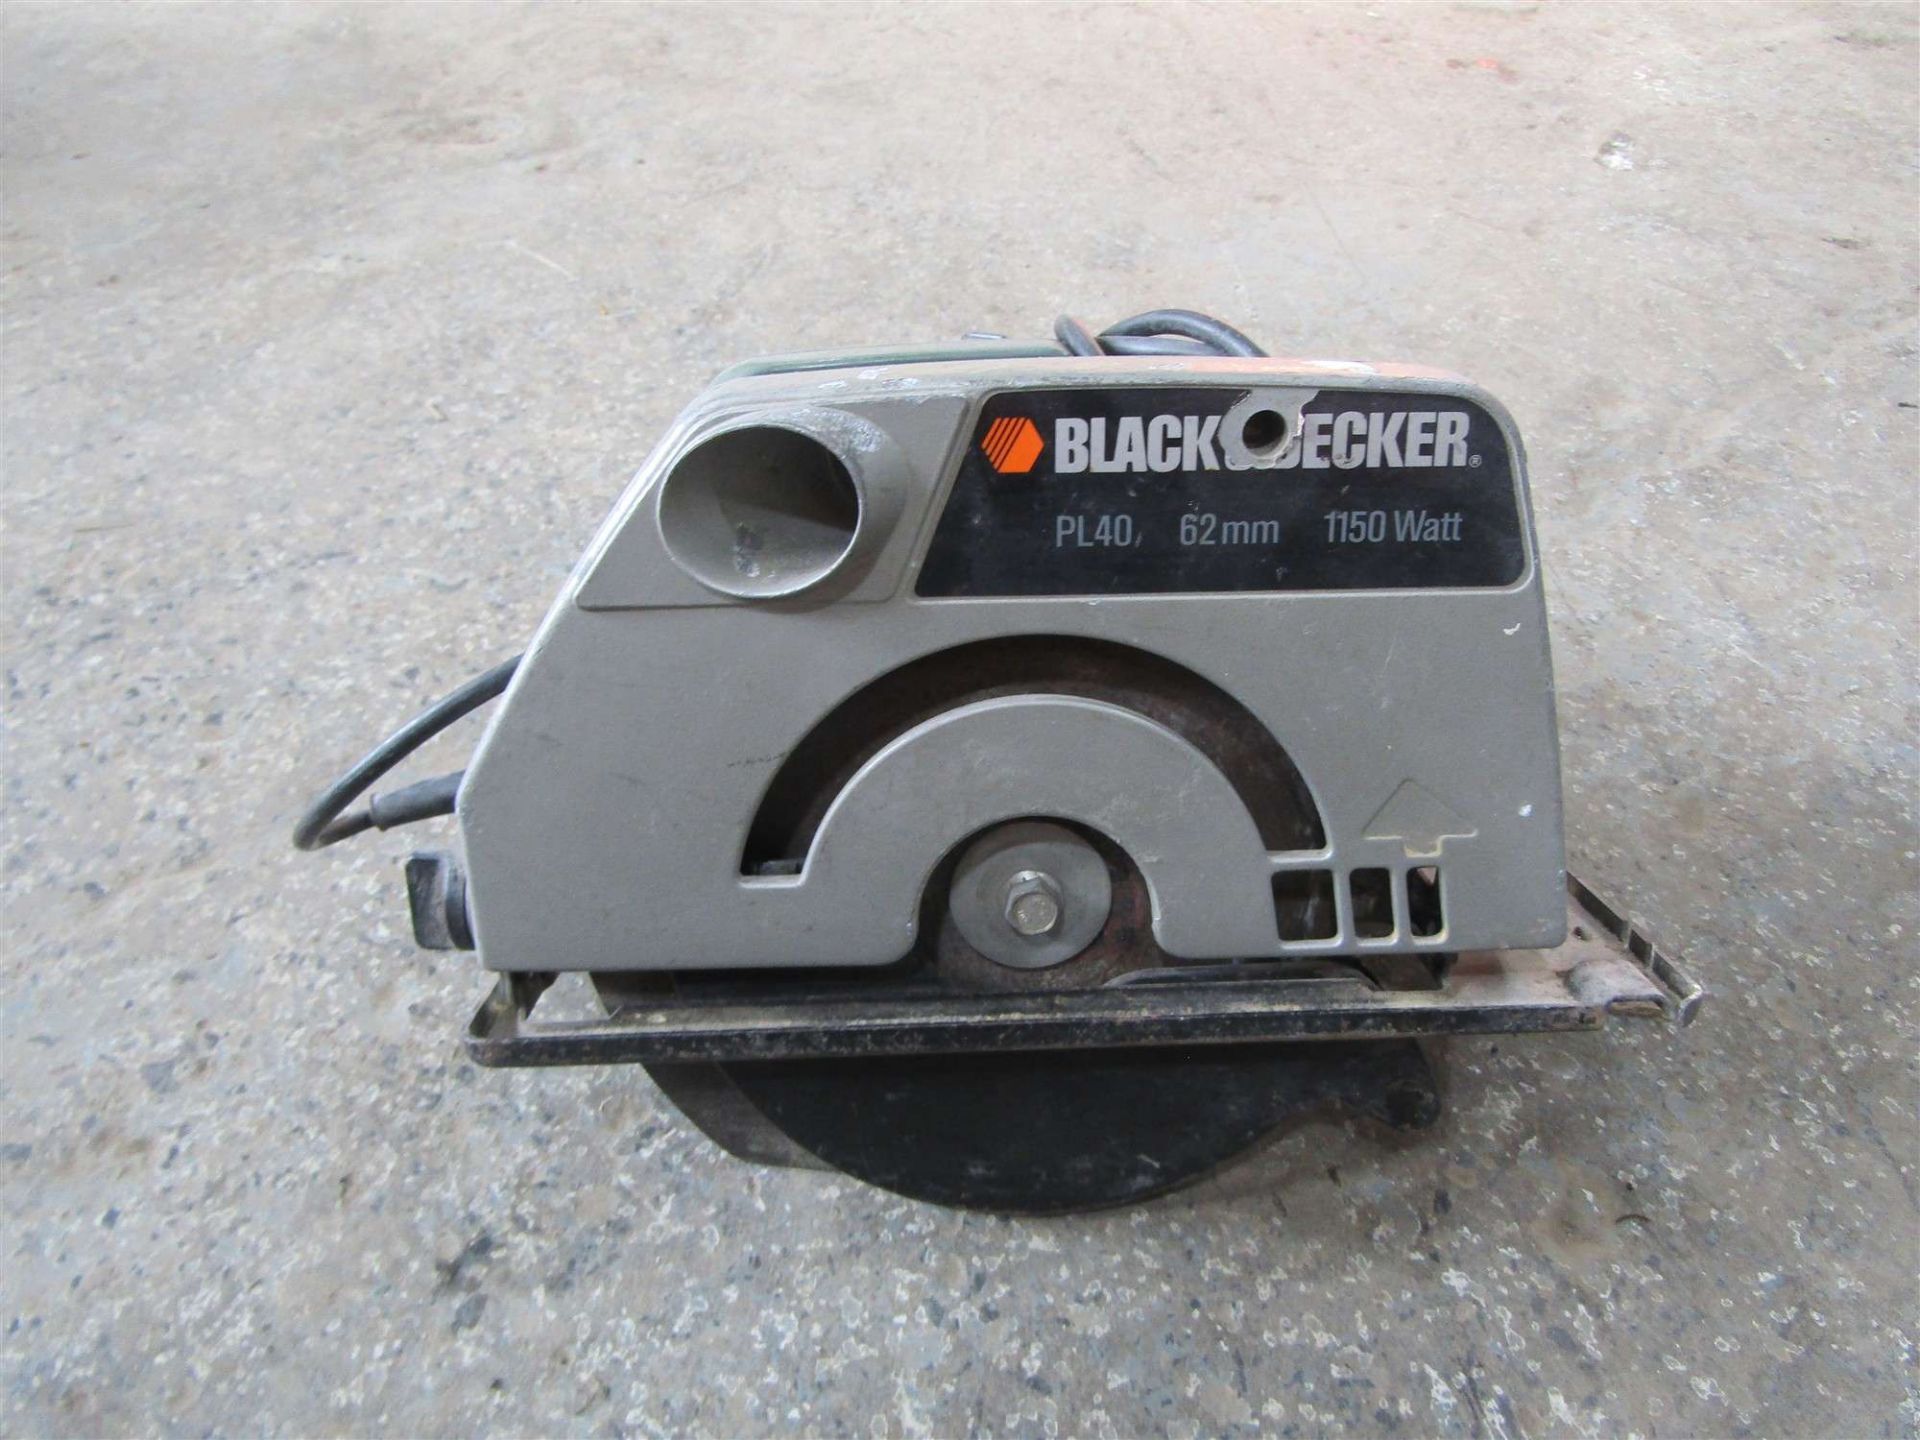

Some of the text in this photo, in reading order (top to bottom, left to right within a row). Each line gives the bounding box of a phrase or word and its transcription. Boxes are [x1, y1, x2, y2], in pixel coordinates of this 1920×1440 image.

[1056, 514, 1133, 547] PL40
[1324, 510, 1387, 543] 1150
[1393, 509, 1463, 542] Watt
